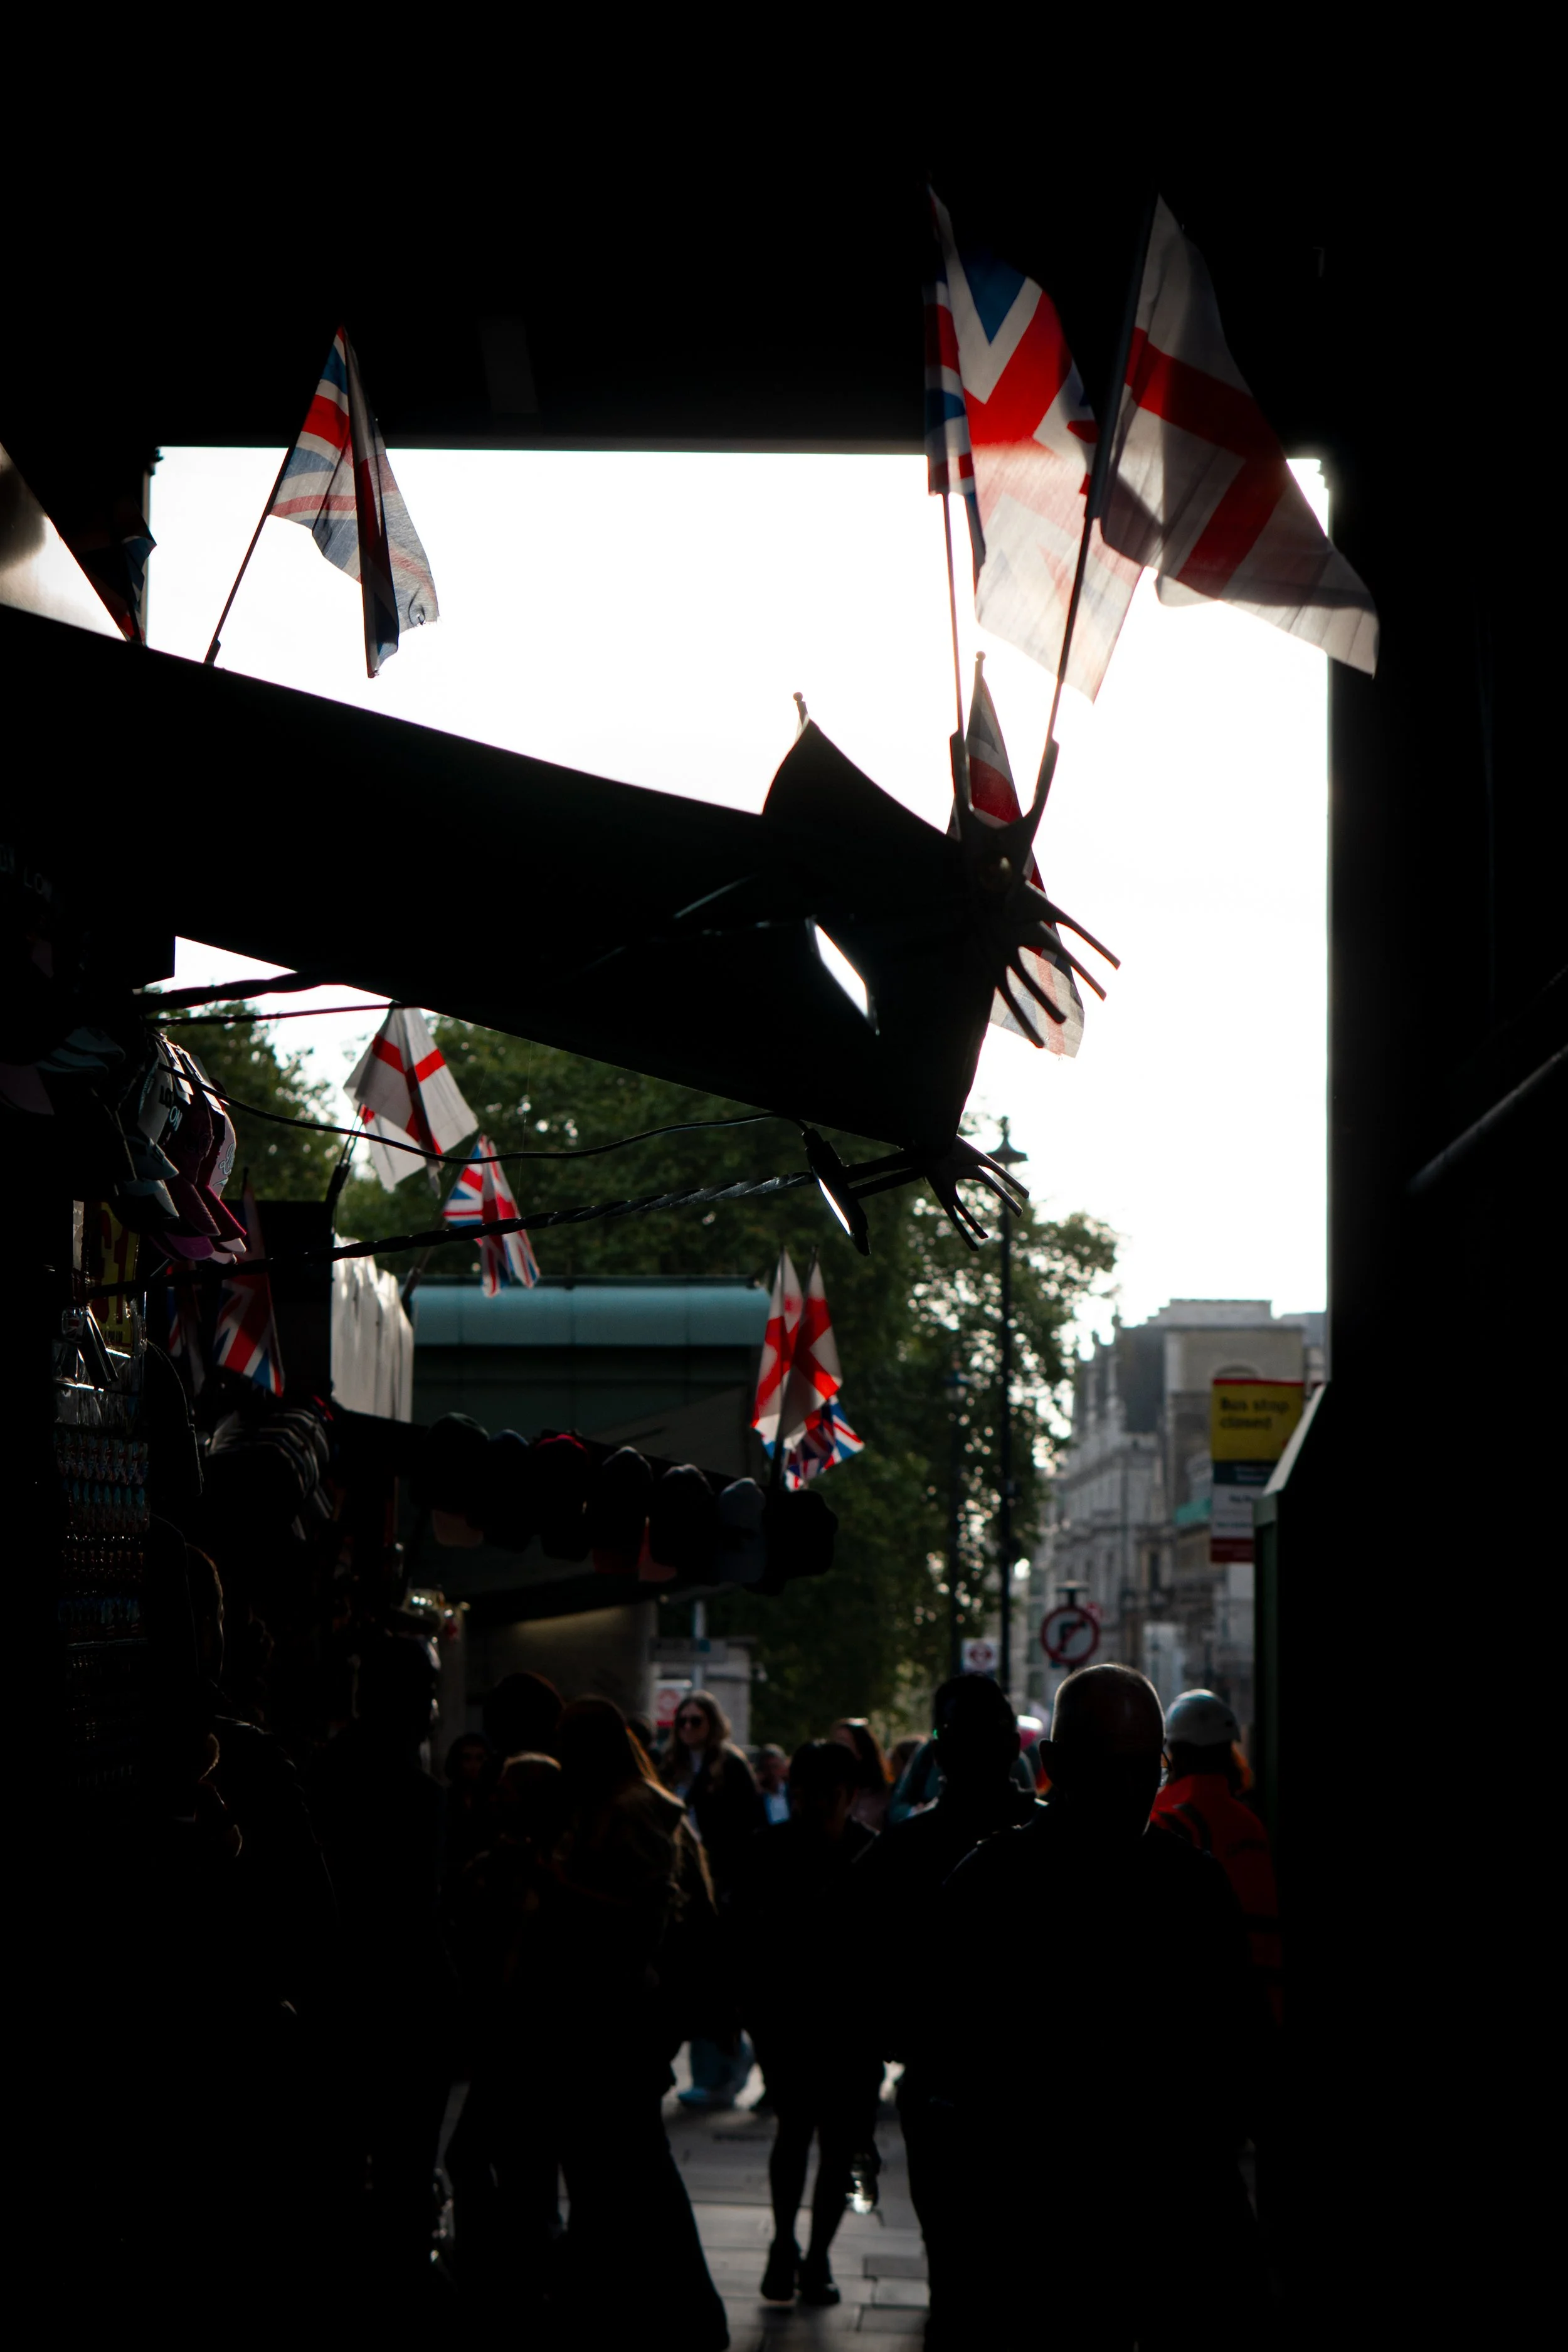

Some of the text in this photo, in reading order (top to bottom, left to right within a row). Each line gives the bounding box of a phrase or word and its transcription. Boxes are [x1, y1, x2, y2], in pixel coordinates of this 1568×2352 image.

[1220, 1396, 1290, 1415] Bus stop
[1220, 1415, 1273, 1430] closed
